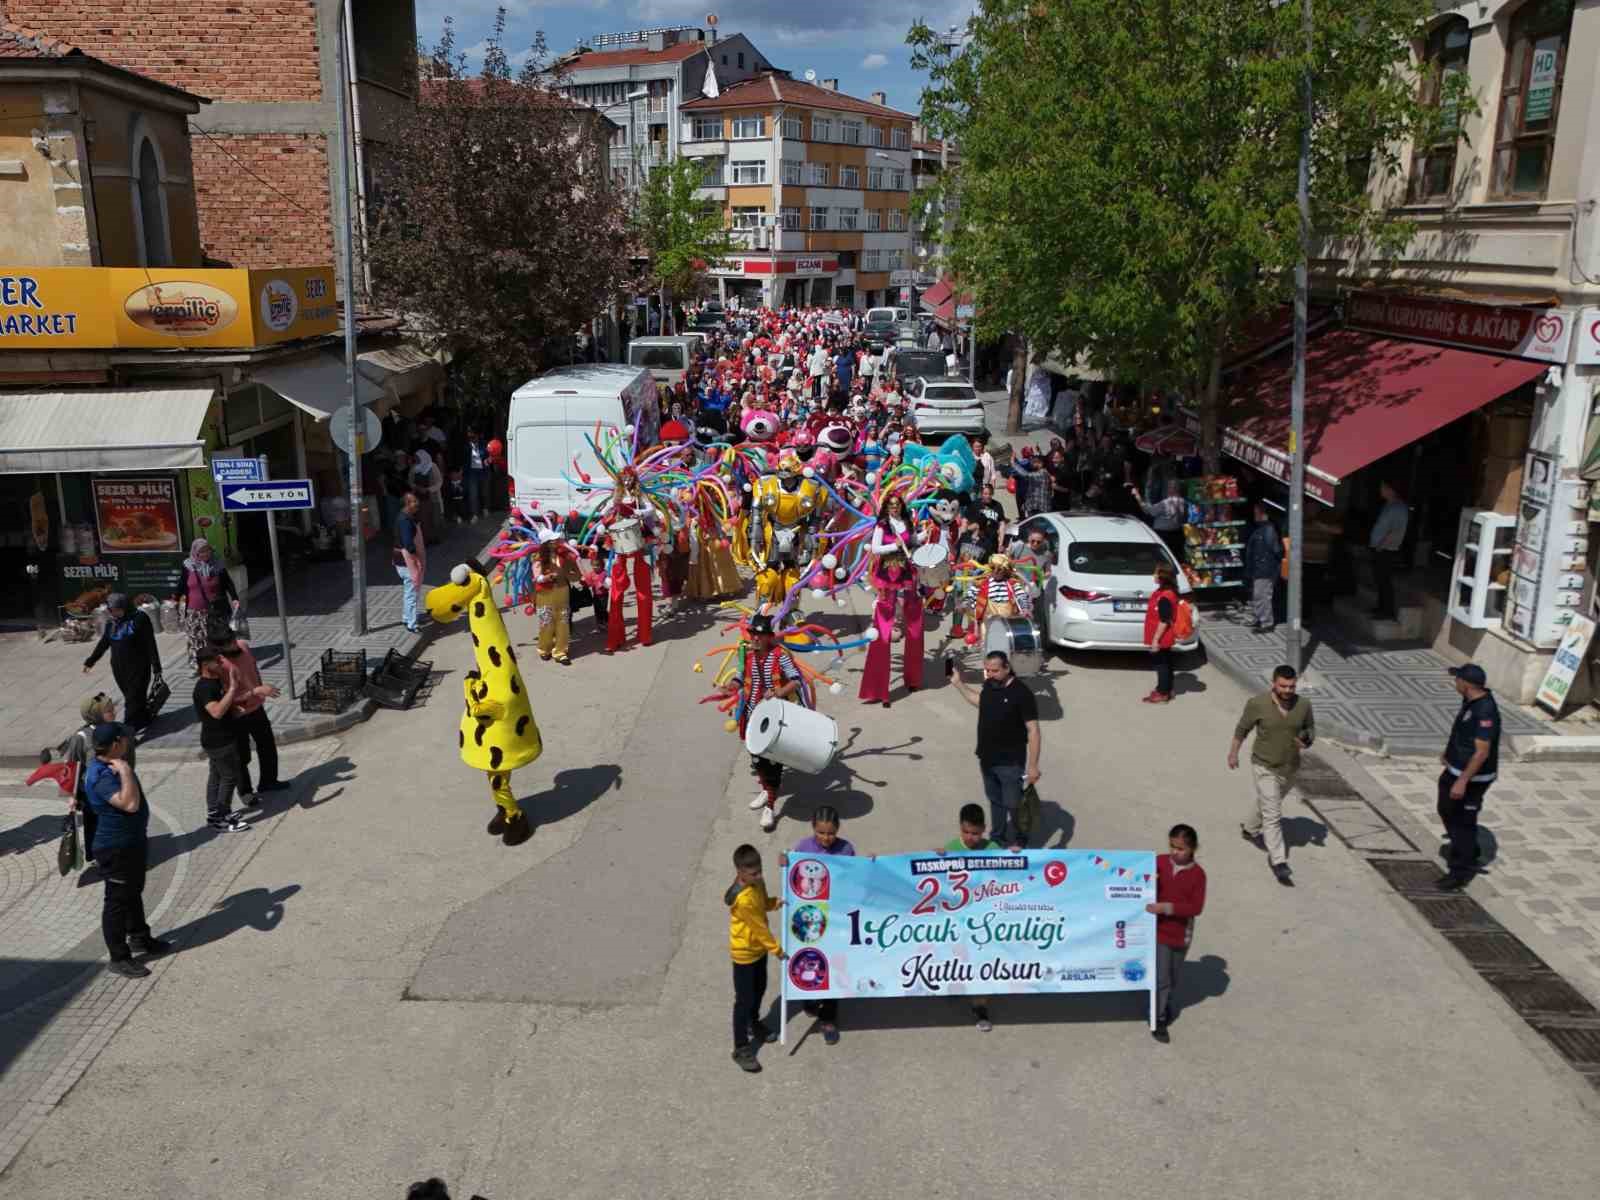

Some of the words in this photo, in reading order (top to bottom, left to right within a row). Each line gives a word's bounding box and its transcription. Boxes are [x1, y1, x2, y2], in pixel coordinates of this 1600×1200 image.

[1535, 53, 1553, 73] HD
[0, 314, 77, 335] ARKET
[1471, 314, 1521, 342] AKTAR
[97, 485, 136, 496] SEZER
[250, 492, 272, 500] TEK
[63, 566, 93, 578] SEZER
[915, 858, 966, 873] TAŞKÖPRÜ
[967, 857, 1025, 870] BELEDİYESİ
[911, 872, 970, 915] 23
[973, 879, 1020, 902] Nisan
[864, 914, 960, 952] Çocuk
[901, 953, 973, 991] Kutlu
[979, 957, 1043, 982] olsun
